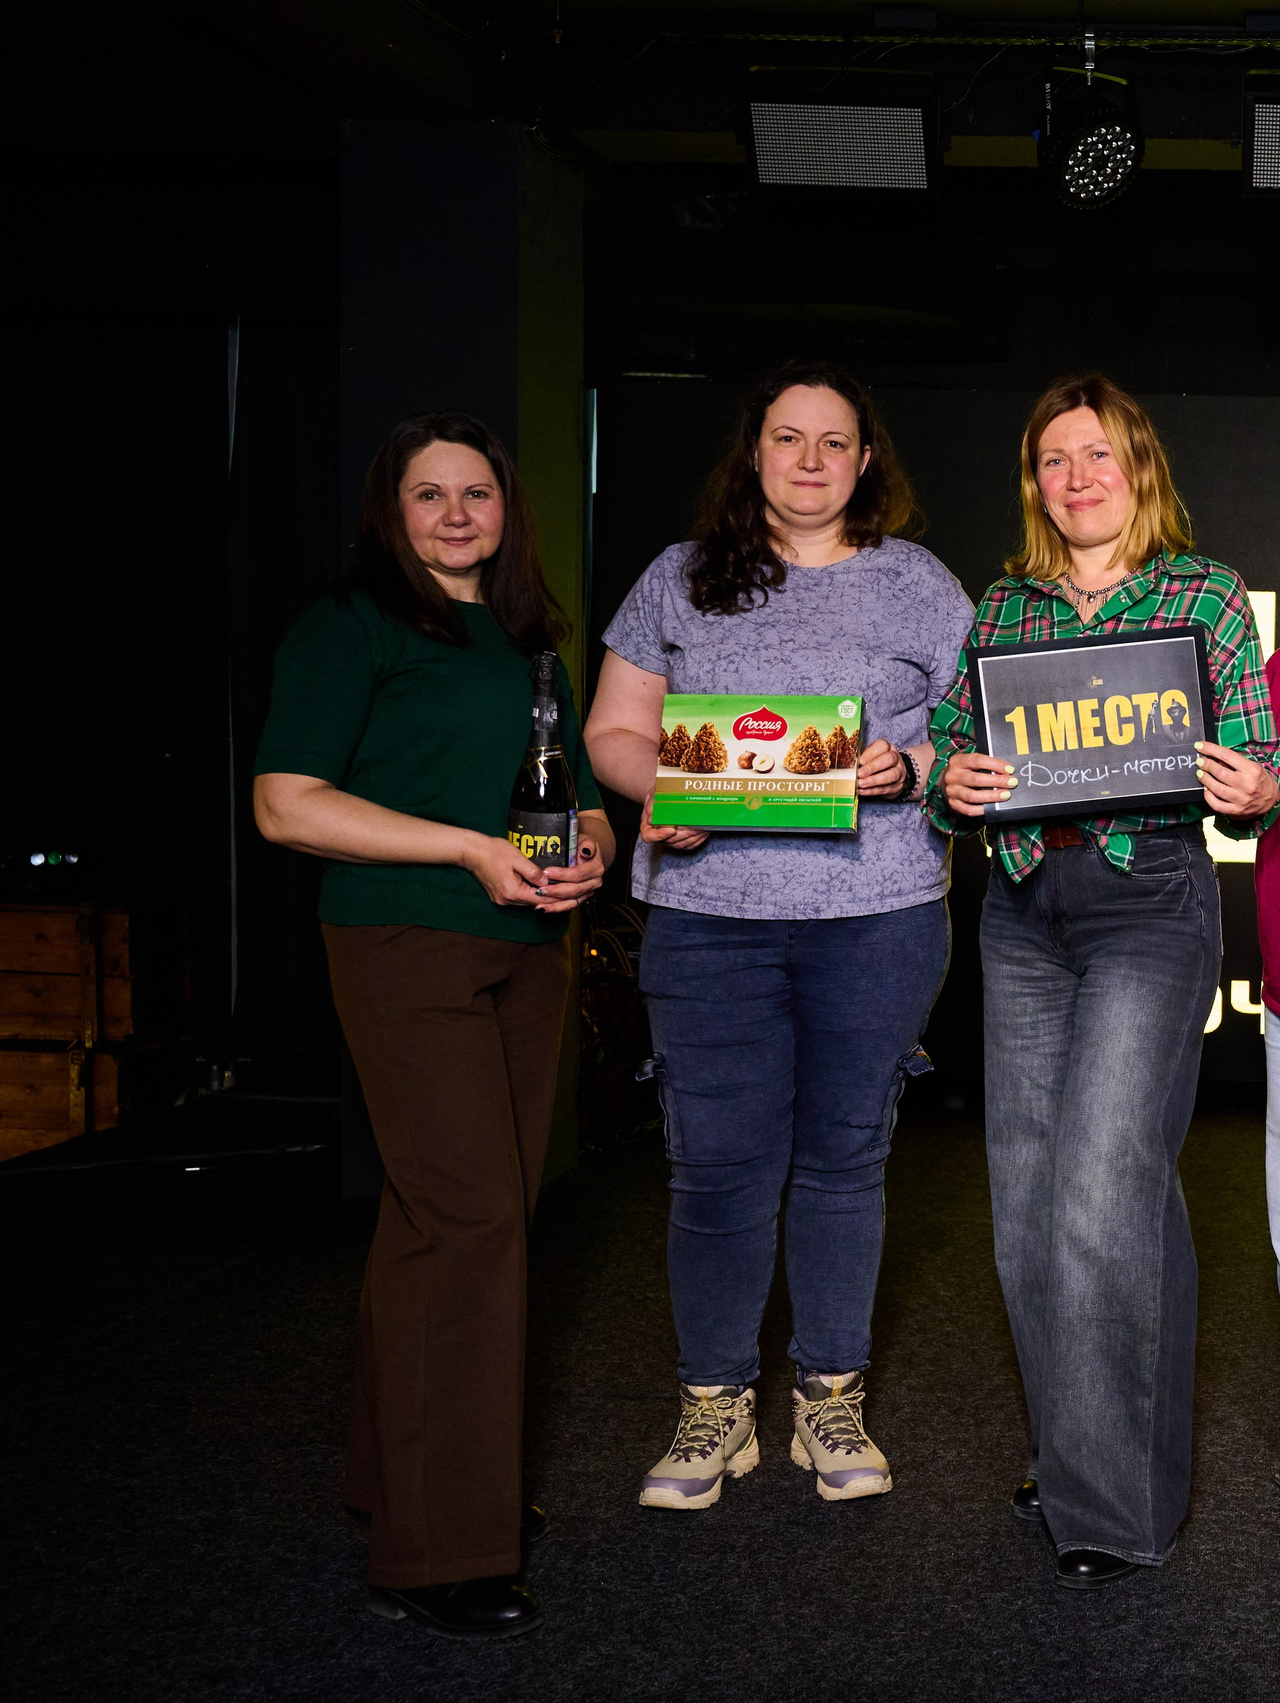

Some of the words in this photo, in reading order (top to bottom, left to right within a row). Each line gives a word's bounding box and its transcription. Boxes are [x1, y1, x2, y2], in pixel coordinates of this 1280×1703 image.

[738, 716, 783, 732] Россия
[1005, 705, 1030, 755] 1
[1036, 689, 1191, 753] МЕСТО
[684, 780, 744, 792] РОДНЫЕ
